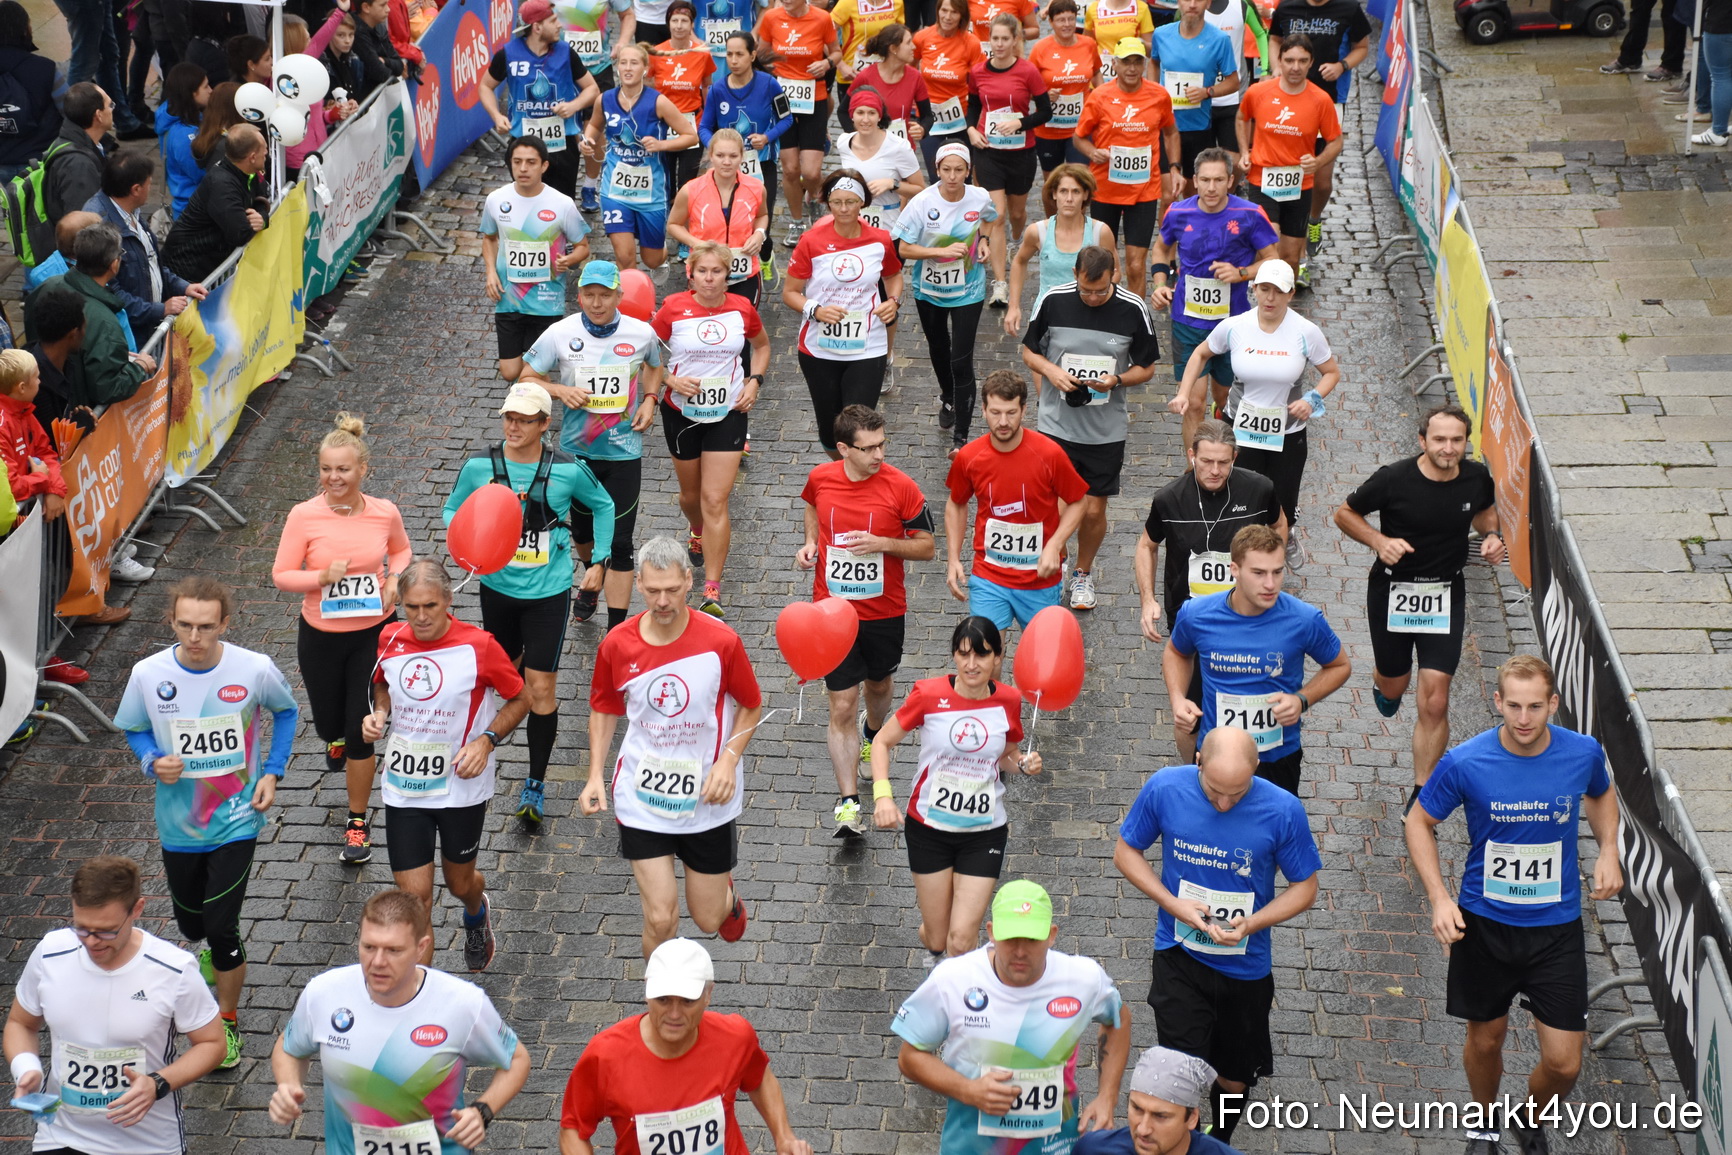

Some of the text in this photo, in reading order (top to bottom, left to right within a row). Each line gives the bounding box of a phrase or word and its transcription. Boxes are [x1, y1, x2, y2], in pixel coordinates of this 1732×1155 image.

[709, 30, 738, 44] 250
[452, 29, 490, 93] Hervis
[508, 60, 531, 77] 13
[719, 101, 730, 115] 9
[1051, 102, 1081, 116] 2295
[415, 82, 440, 152] Hervis
[1113, 121, 1145, 129] funrunners
[1264, 121, 1300, 131] funrunners
[1273, 128, 1303, 137] neumarkt
[1113, 155, 1148, 171] 3085
[615, 171, 650, 189] 2675
[1266, 171, 1301, 187] 2698
[1271, 189, 1293, 197] Thomas
[603, 210, 624, 224] 22
[508, 250, 547, 267] 2079
[516, 270, 547, 278] Carlos
[925, 266, 961, 285] 2517
[1192, 287, 1222, 304] 303
[1199, 306, 1213, 315] Fritz
[822, 321, 862, 338] 3017
[587, 376, 621, 396] 173
[592, 399, 616, 408] Martin
[693, 409, 719, 417] Annette
[1238, 413, 1282, 434] 2409
[1248, 433, 1269, 443] Birgit
[990, 532, 1038, 553] 2314
[997, 554, 1029, 564] Raphael
[830, 560, 878, 581] 2263
[328, 576, 375, 598] 2673
[840, 585, 866, 594] Martin
[1395, 594, 1444, 613] 2901
[1404, 617, 1434, 626] Herbert
[1210, 651, 1261, 664] Kirwaläufer
[1210, 663, 1262, 674] Pettenhofen
[221, 688, 246, 699] Hervis
[416, 707, 457, 718] MIT HERZ
[1224, 707, 1277, 730] 2140
[640, 719, 706, 731] LAUFEN MIT HERZ
[179, 728, 239, 755] 2466
[189, 757, 232, 770] Christian
[390, 750, 445, 777] 2049
[402, 779, 427, 791] Josef
[640, 769, 695, 795] 2226
[648, 796, 683, 811] Rüdiger
[934, 787, 991, 815] 2048
[1490, 800, 1550, 812] Kirwaläufer
[1489, 813, 1551, 824] Pettenhofen
[1173, 838, 1229, 859] Kirwaläufer
[1173, 849, 1229, 870] Pettenhofen
[1492, 856, 1553, 882] 2141
[1508, 885, 1537, 897] Michi
[1050, 1000, 1079, 1013] Hervis
[328, 1034, 351, 1046] PARTL
[415, 1030, 444, 1042] Hervis
[80, 1094, 121, 1107] Denni
[999, 1116, 1044, 1128] Andreas
[648, 1119, 719, 1155] 2078
[363, 1139, 432, 1155] 2115
